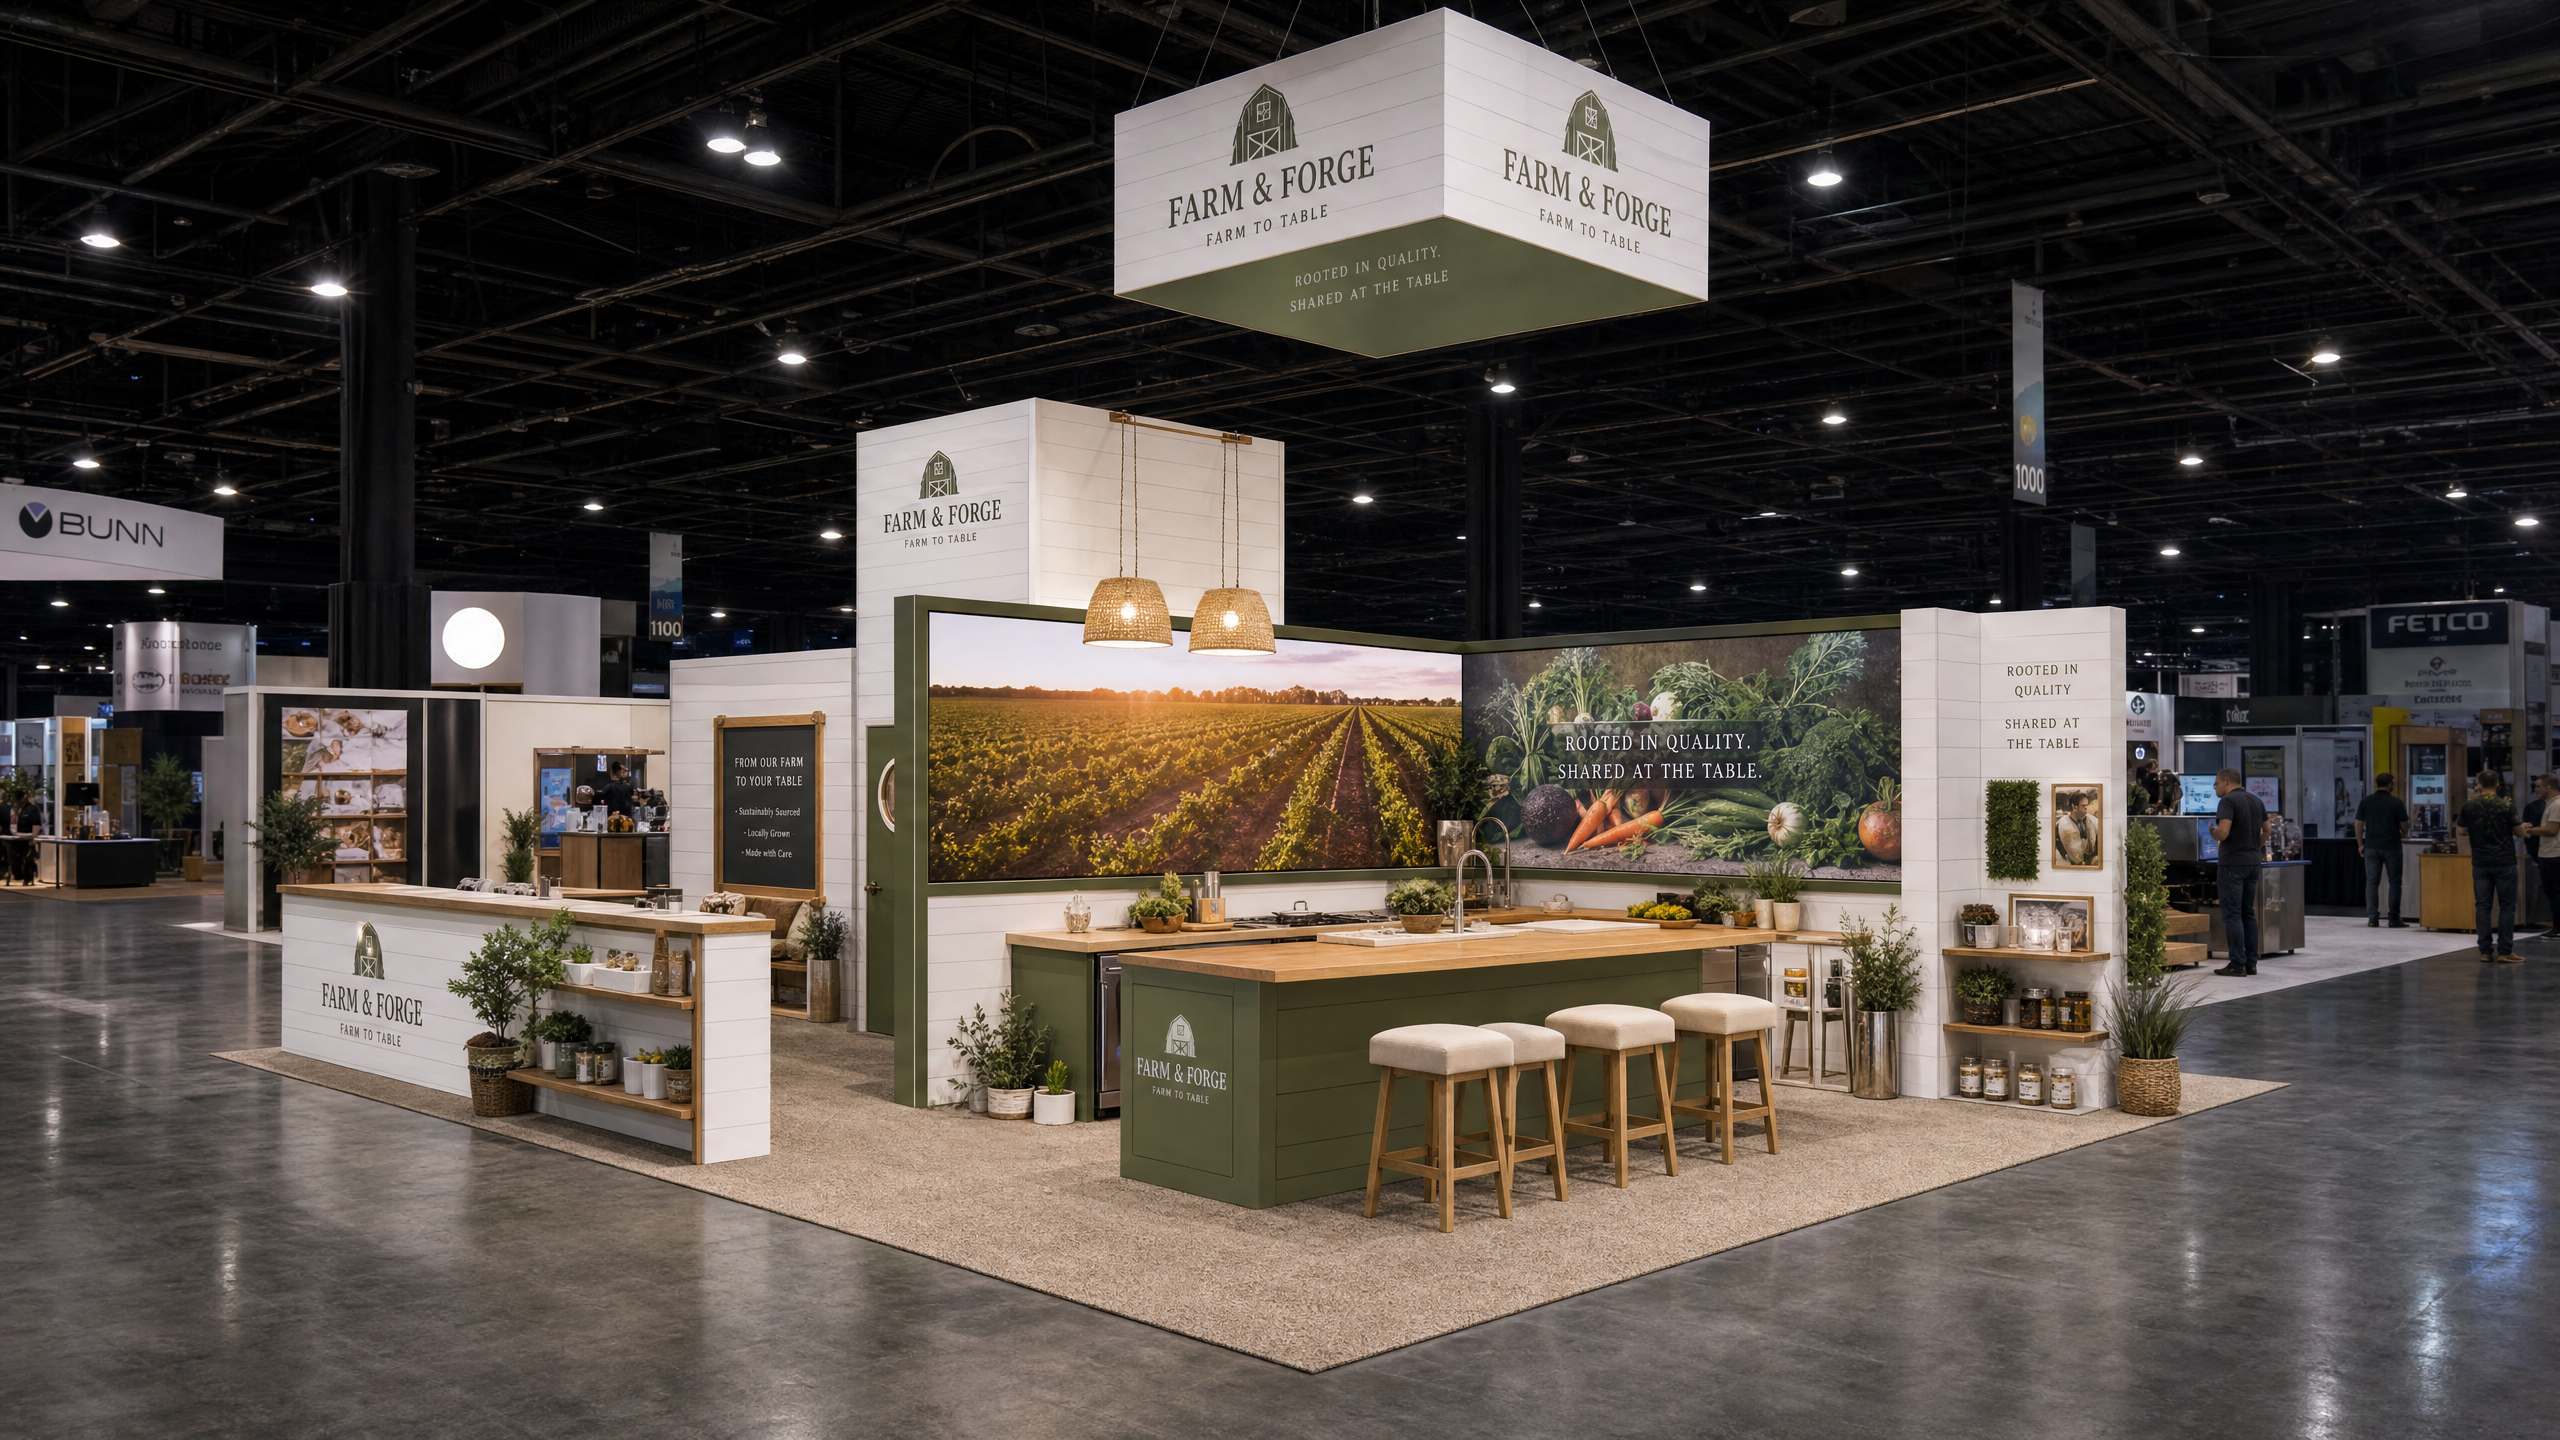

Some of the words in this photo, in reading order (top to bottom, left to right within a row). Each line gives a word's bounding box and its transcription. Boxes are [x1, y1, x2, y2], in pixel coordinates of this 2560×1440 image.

[1168, 180, 1245, 229] FARM
[1252, 172, 1273, 206] &
[1281, 144, 1375, 199] FORGE
[1503, 148, 1571, 203] FARM
[1578, 176, 1596, 210] &
[1602, 184, 1672, 238] FORGE
[1205, 224, 1246, 247] FARM
[1253, 219, 1274, 236] TO
[1280, 204, 1329, 229] TABLE
[1539, 208, 1574, 232] FARM
[1580, 222, 1596, 239] TO
[1602, 229, 1641, 254] TABLE
[1294, 263, 1348, 288] ROOTED
[1355, 260, 1370, 275] IN
[1378, 244, 1441, 273] QUALITY.
[1290, 288, 1344, 313] SHARED
[1350, 285, 1368, 301] AT
[1374, 278, 1401, 296] THE
[1407, 269, 1449, 292] TABLE
[2015, 463, 2044, 494] 1000
[883, 508, 927, 533] FARM
[931, 506, 944, 527] &
[948, 499, 1002, 526] FORGE
[59, 512, 164, 548] BUNN
[904, 537, 928, 549] FARM
[932, 535, 944, 545] TO
[948, 532, 977, 544] TABLE
[650, 620, 682, 637] 1100
[2388, 612, 2489, 633] FETCO
[2007, 664, 2059, 677] ROOTED
[2065, 663, 2078, 675] IN
[2014, 684, 2071, 698] QUALITY
[2005, 718, 2057, 729] SHARED
[2063, 717, 2080, 728] AT
[1564, 733, 1633, 752] ROOTED
[1639, 733, 1658, 751] IN
[1666, 732, 1751, 754] QUALITY.
[2007, 738, 2033, 749] THE
[2039, 738, 2080, 749] TABLE
[734, 757, 757, 768] FROM
[760, 757, 777, 768] OUR
[780, 756, 804, 767] FARM
[1558, 763, 1625, 780] SHARED
[1632, 763, 1654, 779] AT
[1660, 763, 1695, 779] THE
[1702, 762, 1762, 779] TABLE.
[735, 775, 747, 787] TO
[749, 775, 772, 787] YOUR
[775, 775, 803, 787] TABLE
[777, 849, 793, 859] Care
[321, 982, 359, 1014] FARM
[362, 989, 373, 1016] &
[376, 992, 423, 1027] FORGE
[340, 1023, 360, 1038] FARM
[363, 1028, 373, 1041] TO
[376, 1031, 402, 1048] TABLE
[1136, 1057, 1171, 1081] FARM
[1174, 1063, 1184, 1083] &
[1186, 1066, 1227, 1090] FORGE
[1152, 1085, 1172, 1097] FARM
[1174, 1090, 1184, 1100] TO
[1186, 1092, 1210, 1105] TABLE
